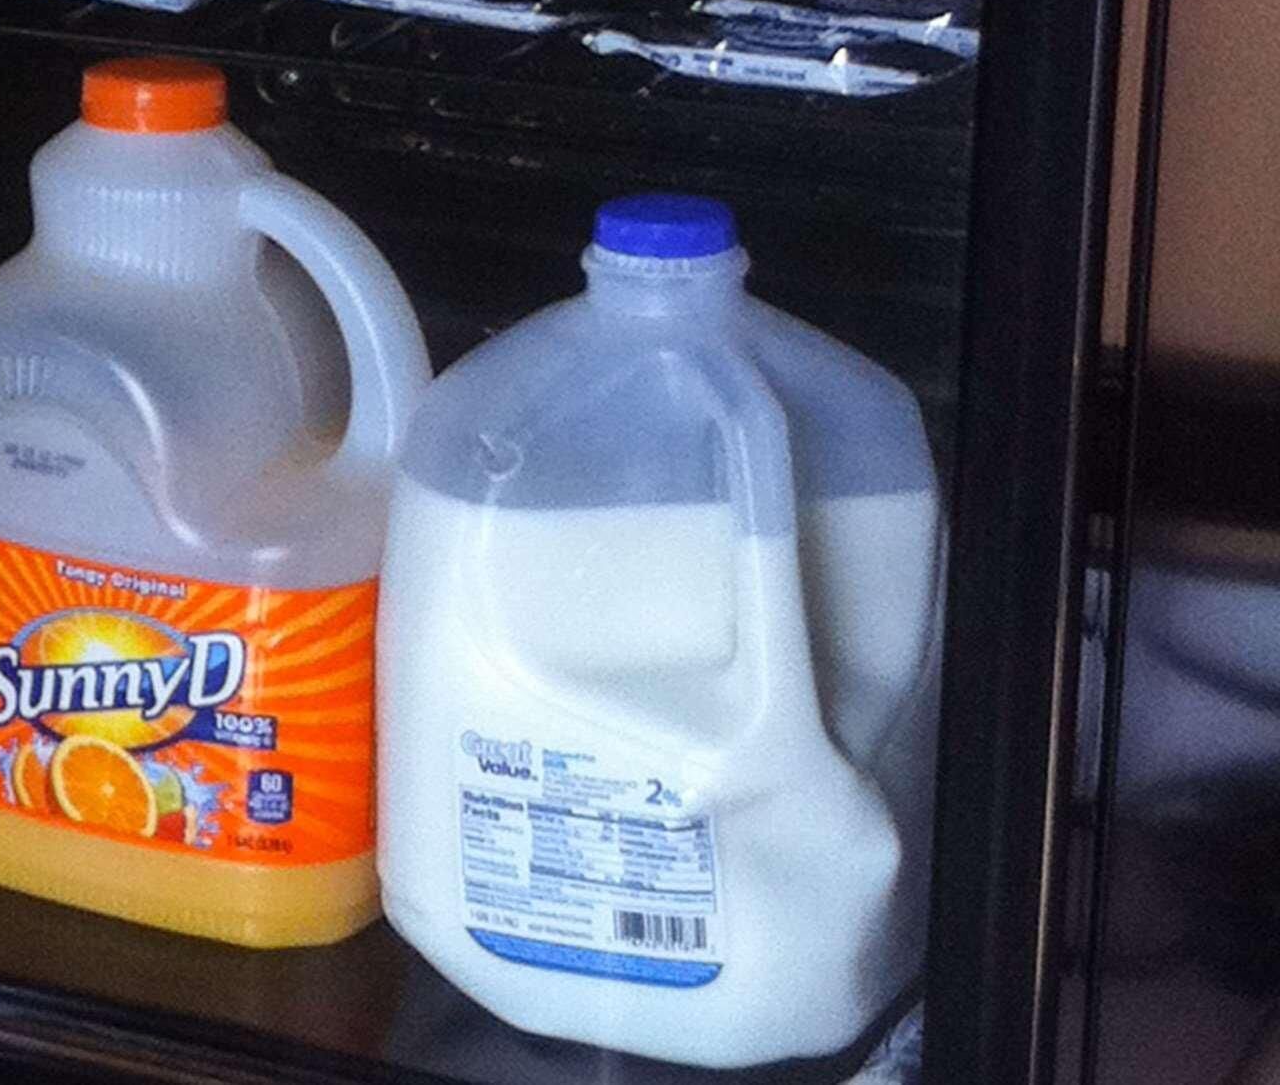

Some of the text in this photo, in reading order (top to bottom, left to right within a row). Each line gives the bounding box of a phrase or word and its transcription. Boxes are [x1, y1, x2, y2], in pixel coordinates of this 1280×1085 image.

[56, 559, 186, 600] Tangy Original
[215, 713, 274, 735] 100%
[477, 756, 533, 780] Value
[260, 771, 283, 793] 60
[645, 778, 683, 807] 2%
[462, 790, 525, 812] Nutrition
[463, 803, 502, 822] Facts
